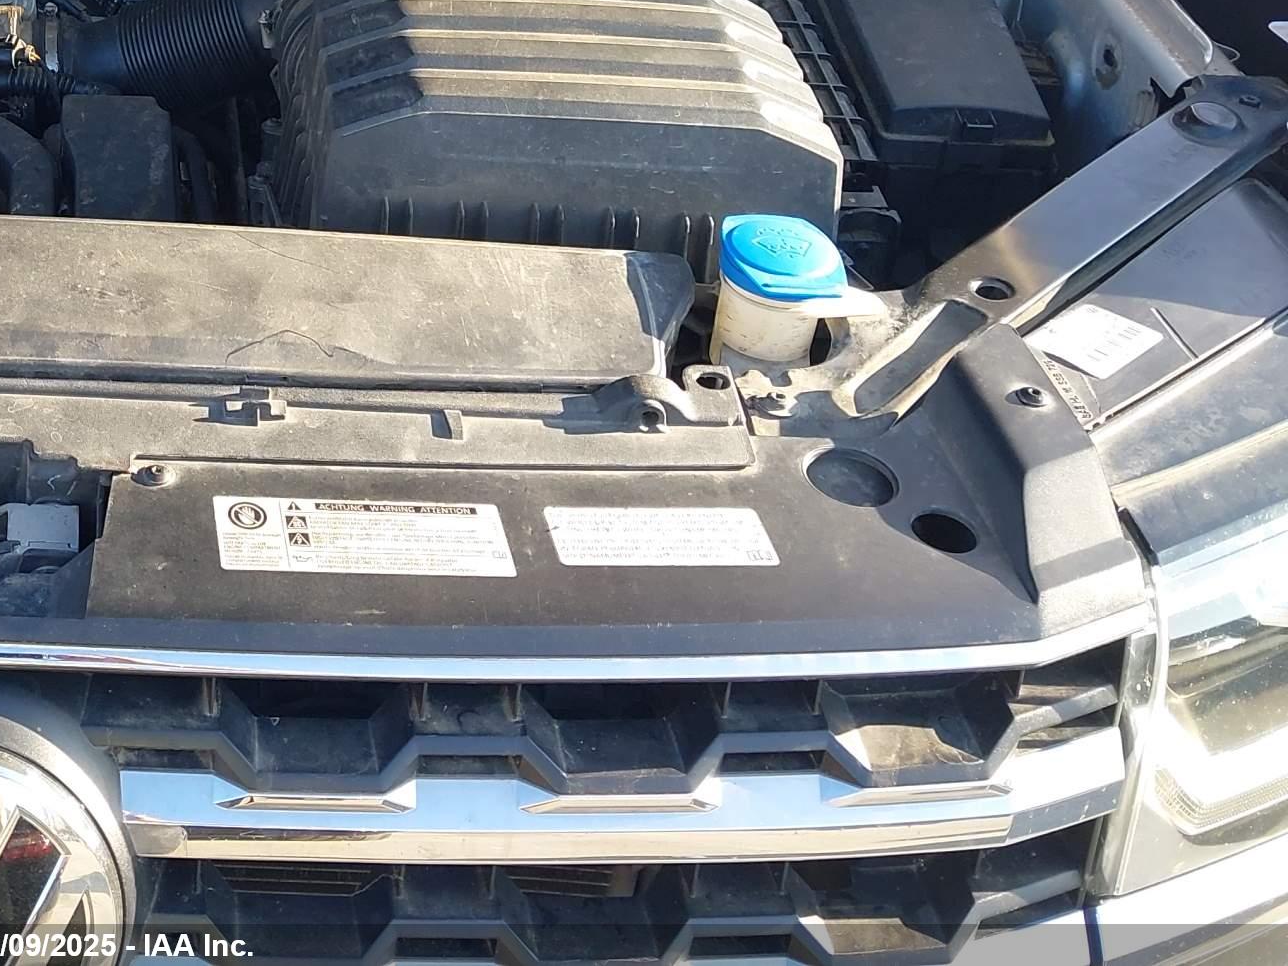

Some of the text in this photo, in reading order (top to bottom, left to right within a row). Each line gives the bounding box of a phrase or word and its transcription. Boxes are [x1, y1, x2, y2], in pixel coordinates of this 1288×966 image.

[319, 503, 471, 515] ACHTUNG WARNING ATTENTION
